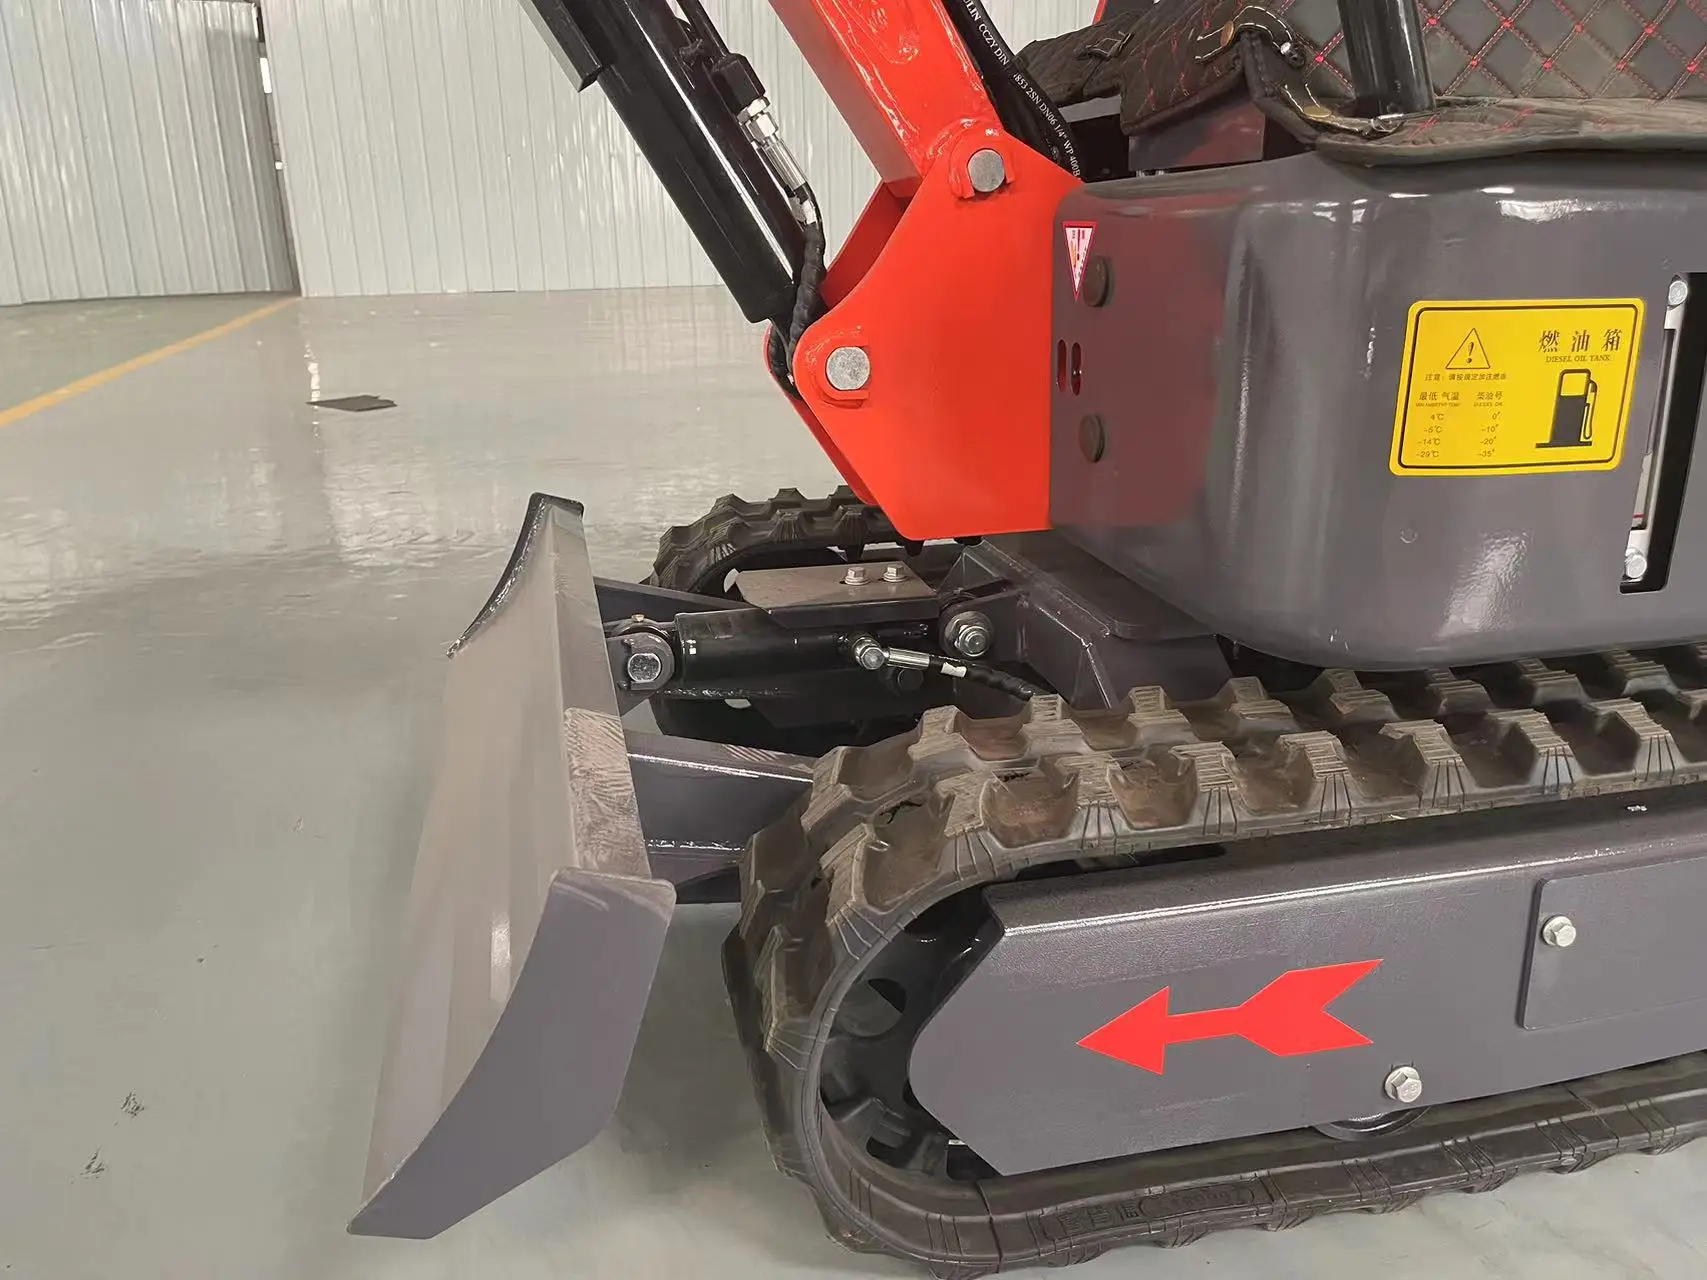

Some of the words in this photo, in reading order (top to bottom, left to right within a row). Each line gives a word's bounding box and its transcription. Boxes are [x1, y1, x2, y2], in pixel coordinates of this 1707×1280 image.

[994, 48, 1011, 66] DIN
[1025, 87, 1042, 105] 2SN
[1039, 102, 1058, 125] DN06
[1063, 139, 1075, 155] WP
[1538, 328, 1623, 353] 燃油箱
[1545, 355, 1573, 363] DIESEL
[1589, 354, 1611, 362] TANK
